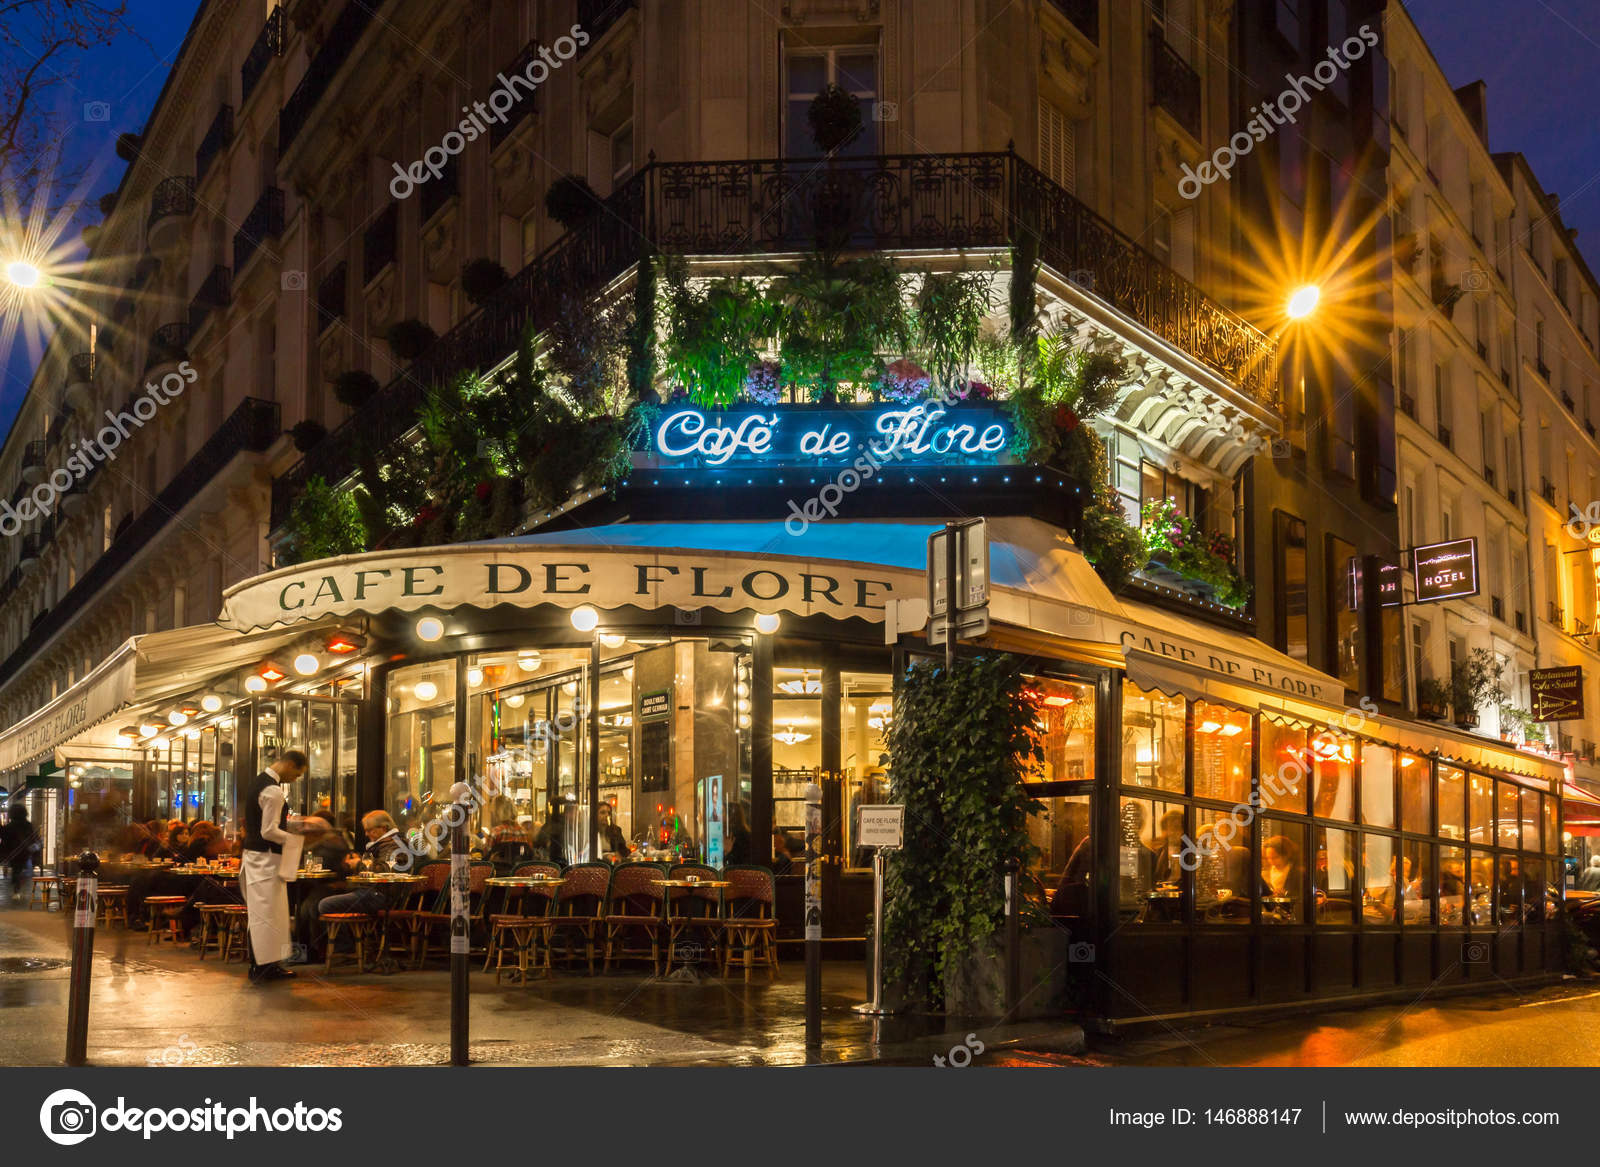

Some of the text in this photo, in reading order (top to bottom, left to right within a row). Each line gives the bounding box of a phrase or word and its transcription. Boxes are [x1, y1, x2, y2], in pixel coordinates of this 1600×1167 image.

[657, 405, 1006, 465] Café de Flore
[278, 563, 893, 611] CAFE DE FLORE
[1425, 572, 1466, 586] HOTEL
[1532, 670, 1577, 680] Restaurant
